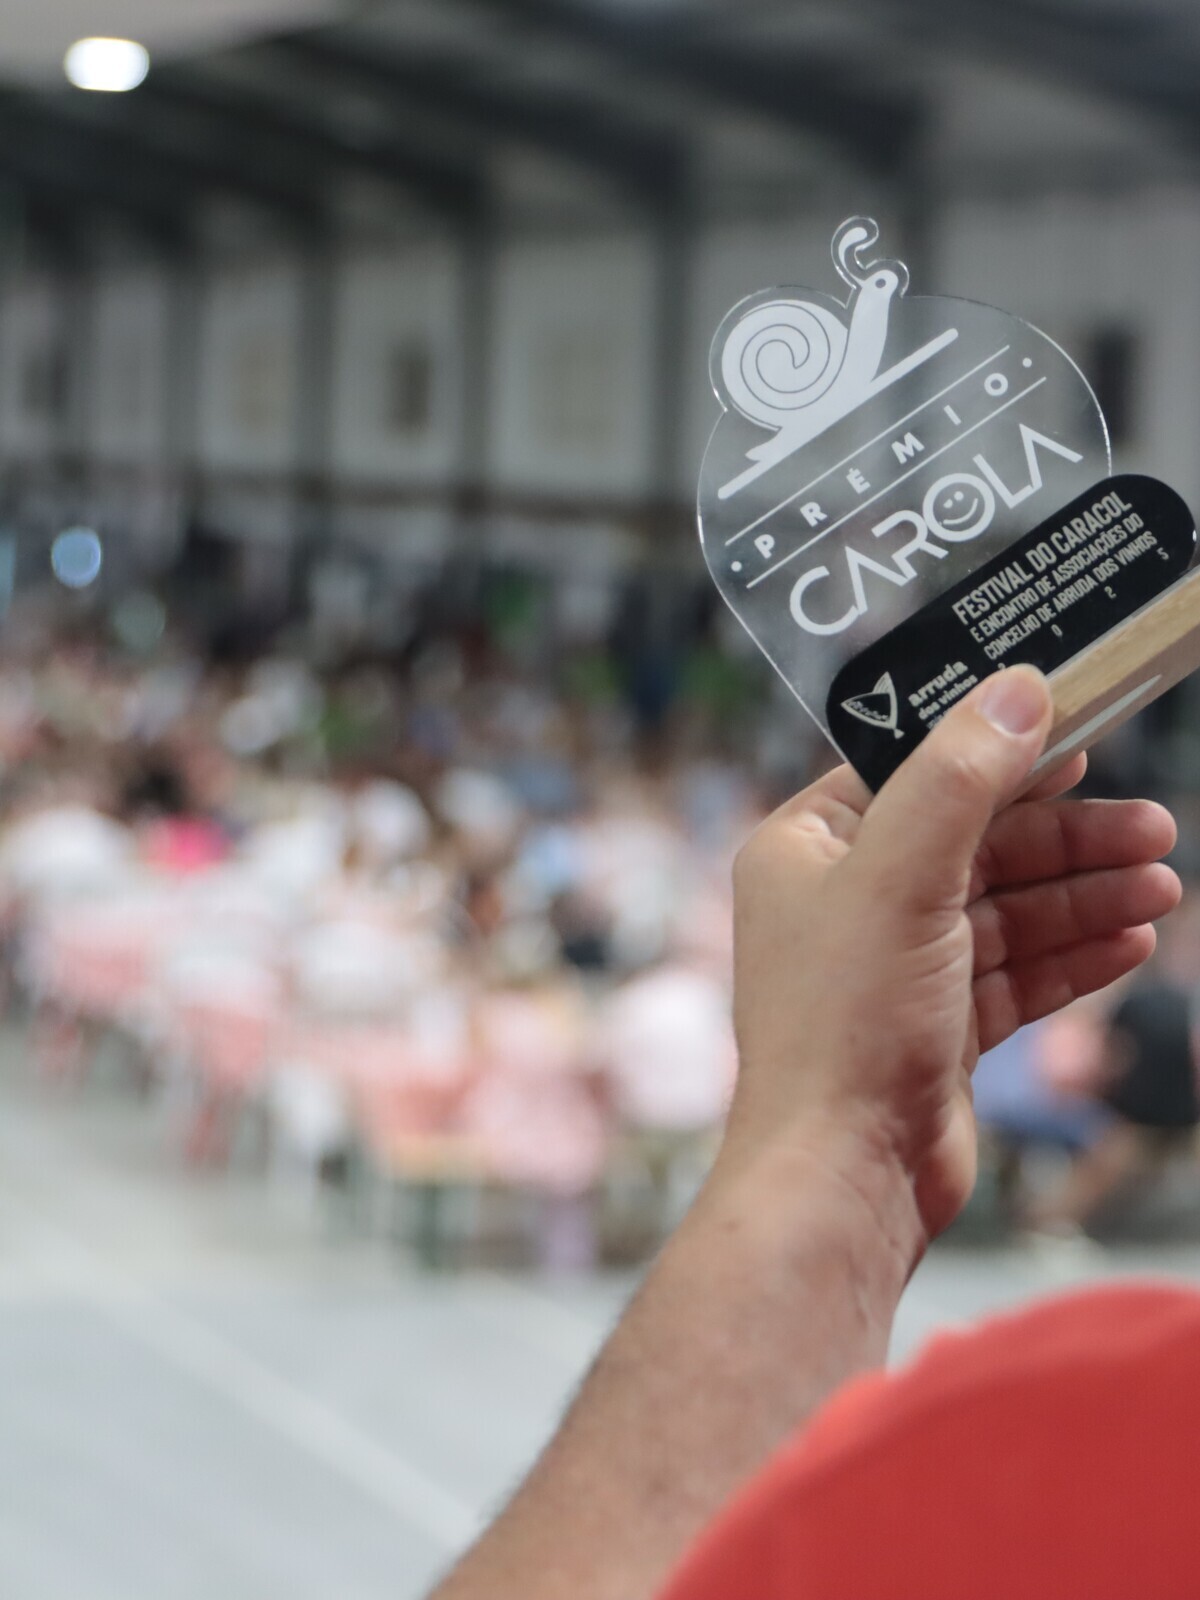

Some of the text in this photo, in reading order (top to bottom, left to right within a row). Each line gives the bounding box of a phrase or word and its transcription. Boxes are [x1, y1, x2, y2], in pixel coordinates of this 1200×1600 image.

[753, 372, 1009, 560] PRÉMIO
[789, 423, 1084, 636] CAROLA
[951, 491, 1133, 626] FESTIVAL DO CARACOL
[969, 512, 1145, 643] E ENCONTRO DE ASSOCIAÇÕES DO
[983, 530, 1158, 660] CONCELHO DE ARRUDA DOS VINHOS
[908, 661, 969, 707] arruda
[918, 701, 941, 720] dos
[938, 674, 978, 705] vinhos
